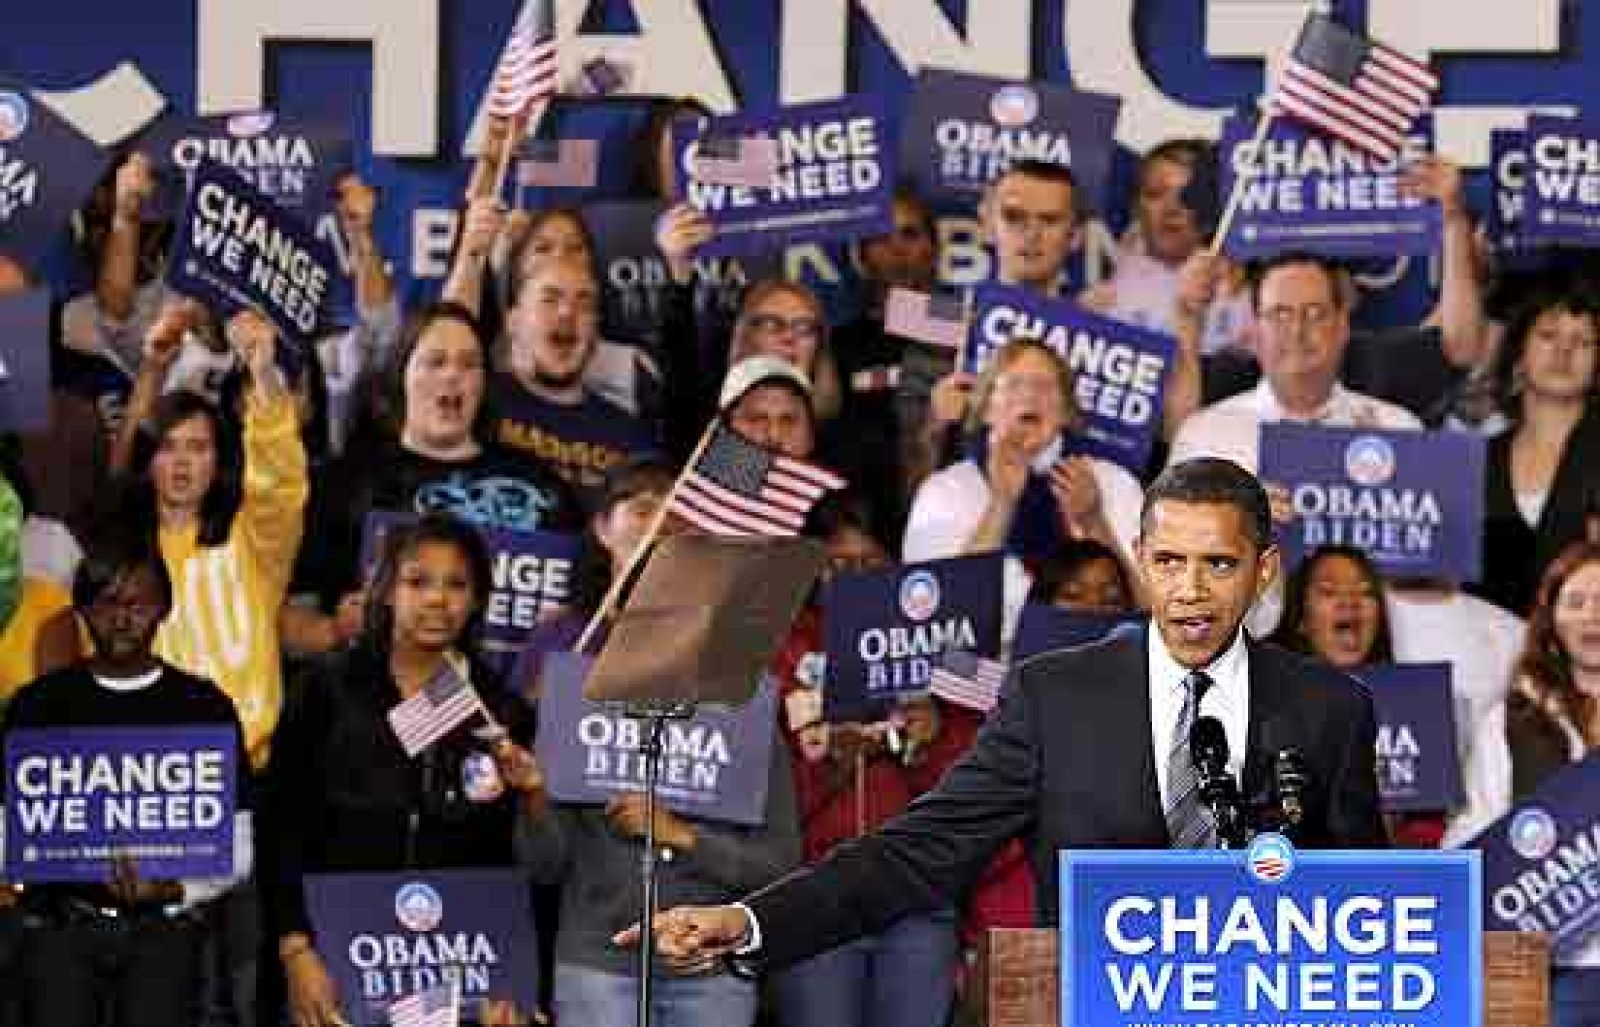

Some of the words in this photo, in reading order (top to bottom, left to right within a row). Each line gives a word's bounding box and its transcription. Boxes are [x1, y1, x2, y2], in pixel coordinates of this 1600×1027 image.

[769, 161, 882, 201] NEED
[1317, 175, 1421, 210] NEE
[198, 183, 327, 304] CHANGE
[193, 215, 246, 273] WE
[250, 256, 317, 332] NEED
[607, 257, 747, 289] OBMA
[1292, 485, 1442, 523] OBAMA
[1303, 518, 1432, 552] BIDEN
[859, 616, 977, 661] OBAMA
[16, 750, 225, 796] CHANGE
[18, 799, 88, 833] WE
[105, 794, 223, 830] NEED
[1491, 820, 1600, 921] OBAM
[1104, 895, 1439, 954] CHANGE
[349, 934, 499, 967] OBAMA
[1106, 962, 1218, 1011] WE
[1246, 962, 1436, 1011] NEED
